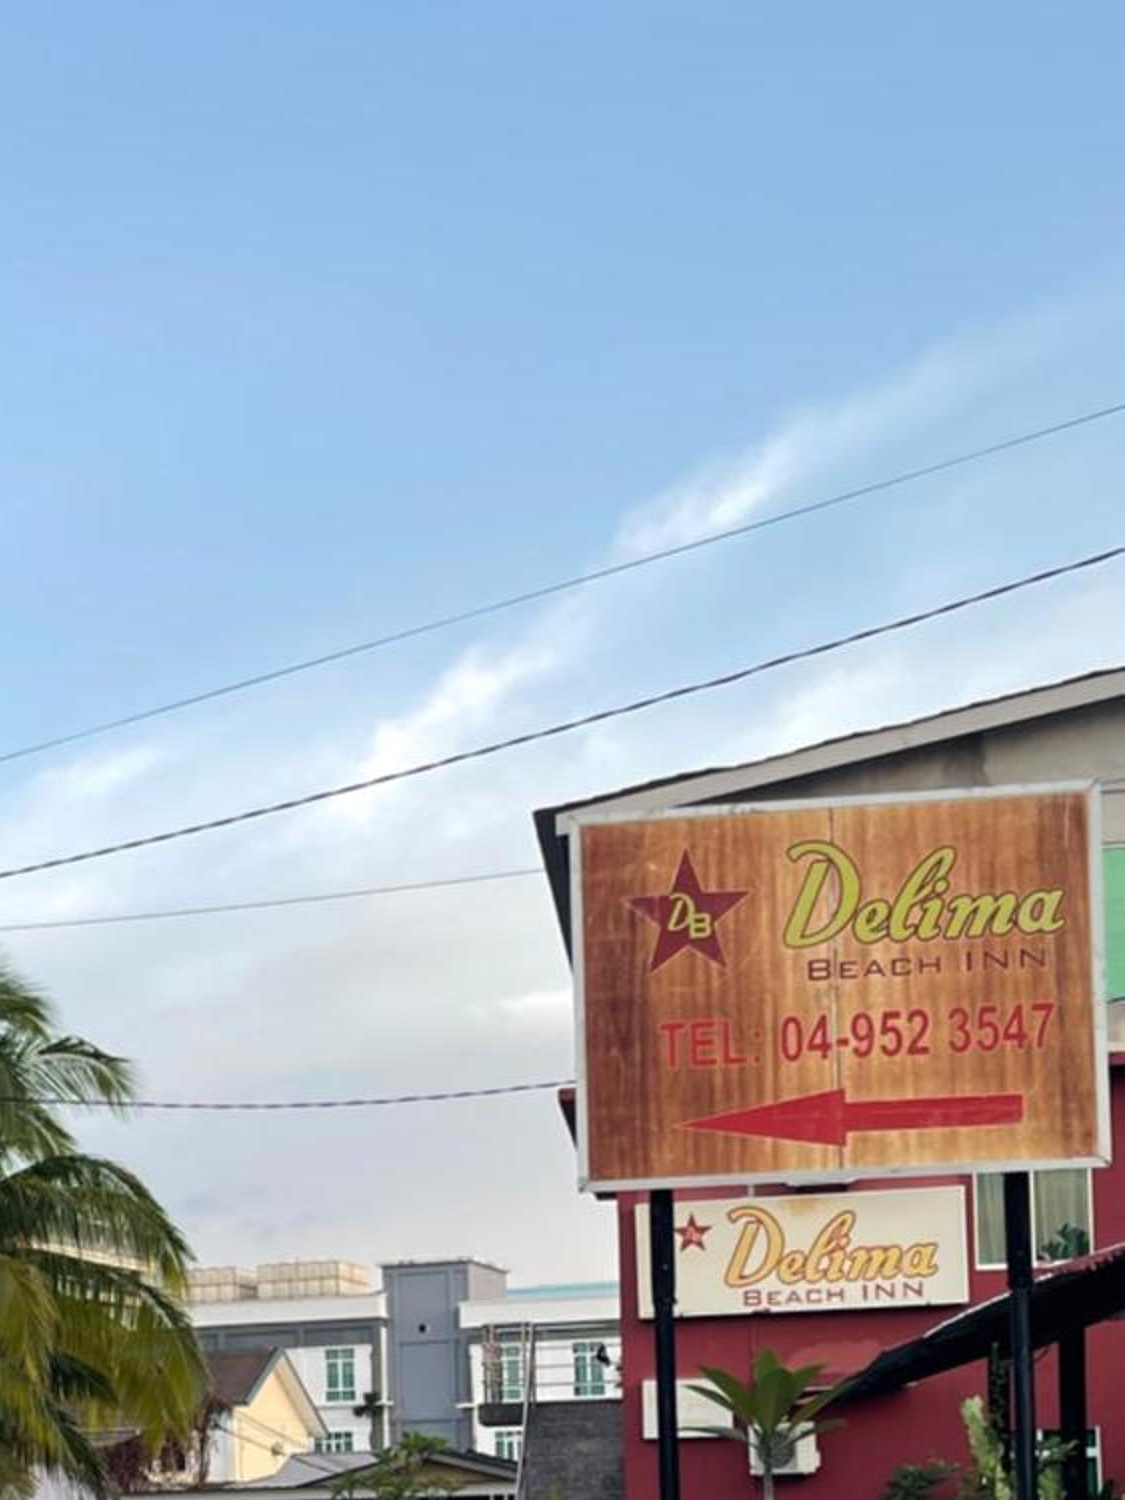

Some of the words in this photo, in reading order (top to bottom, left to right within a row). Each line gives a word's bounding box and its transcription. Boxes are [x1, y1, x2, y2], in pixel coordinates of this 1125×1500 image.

[668, 893, 712, 939] DB
[783, 840, 1066, 950] Delima
[807, 957, 942, 981] BEACH
[966, 950, 1047, 972] INN
[659, 1021, 763, 1067] TEL:
[780, 1008, 930, 1061] 04-952
[947, 1002, 1056, 1054] 3547
[725, 1205, 940, 1289] Delima
[743, 1288, 845, 1307] BEACH
[862, 1279, 924, 1301] INN
